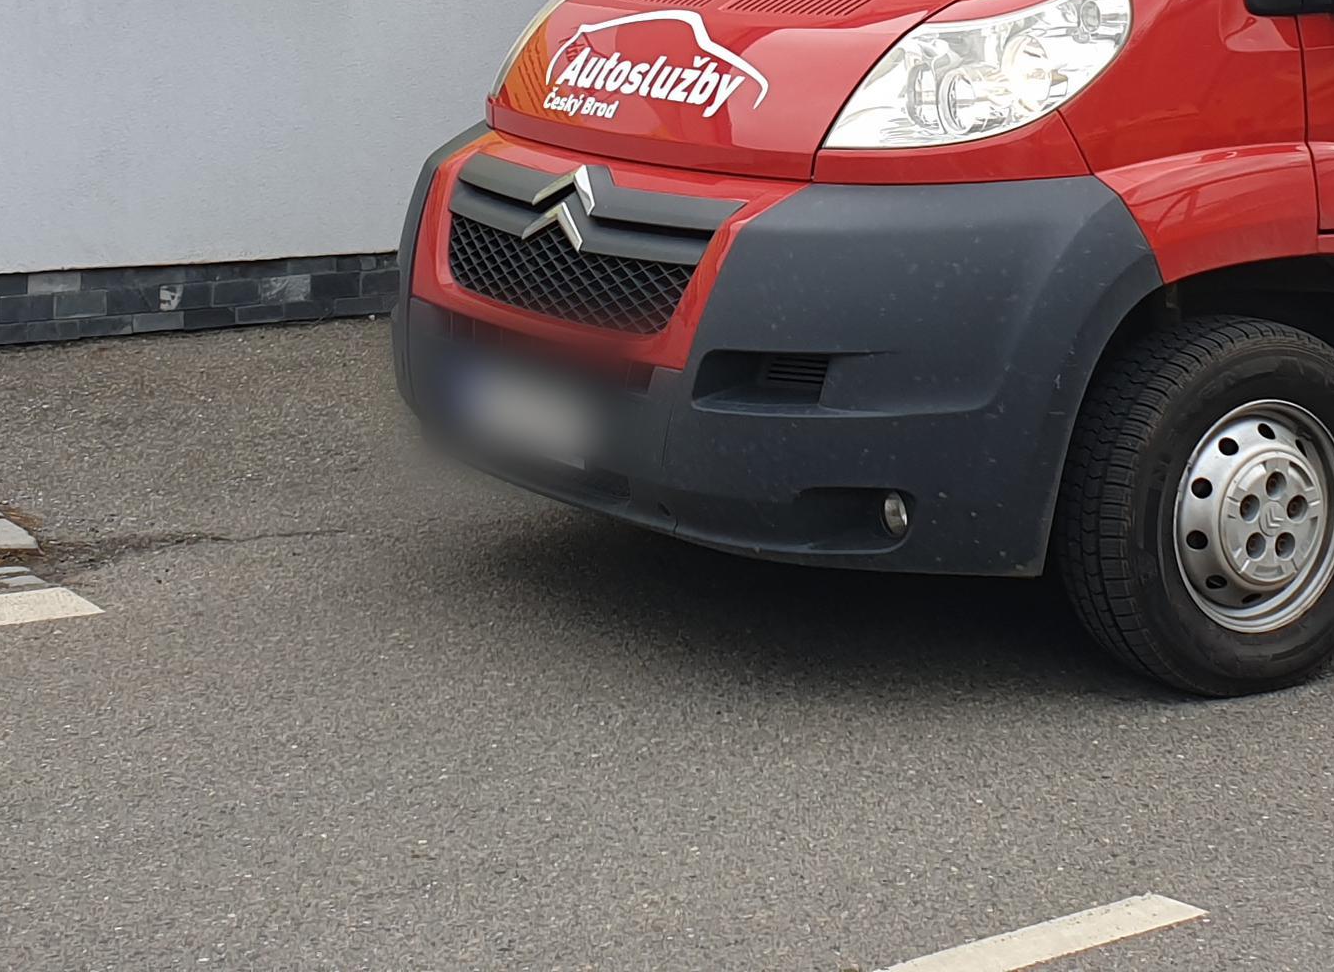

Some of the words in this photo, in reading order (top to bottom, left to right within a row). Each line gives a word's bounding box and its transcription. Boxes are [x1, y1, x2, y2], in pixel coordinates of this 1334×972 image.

[543, 87, 584, 117] Český
[581, 96, 619, 119] Brod
[555, 47, 745, 118] Autoslužby
